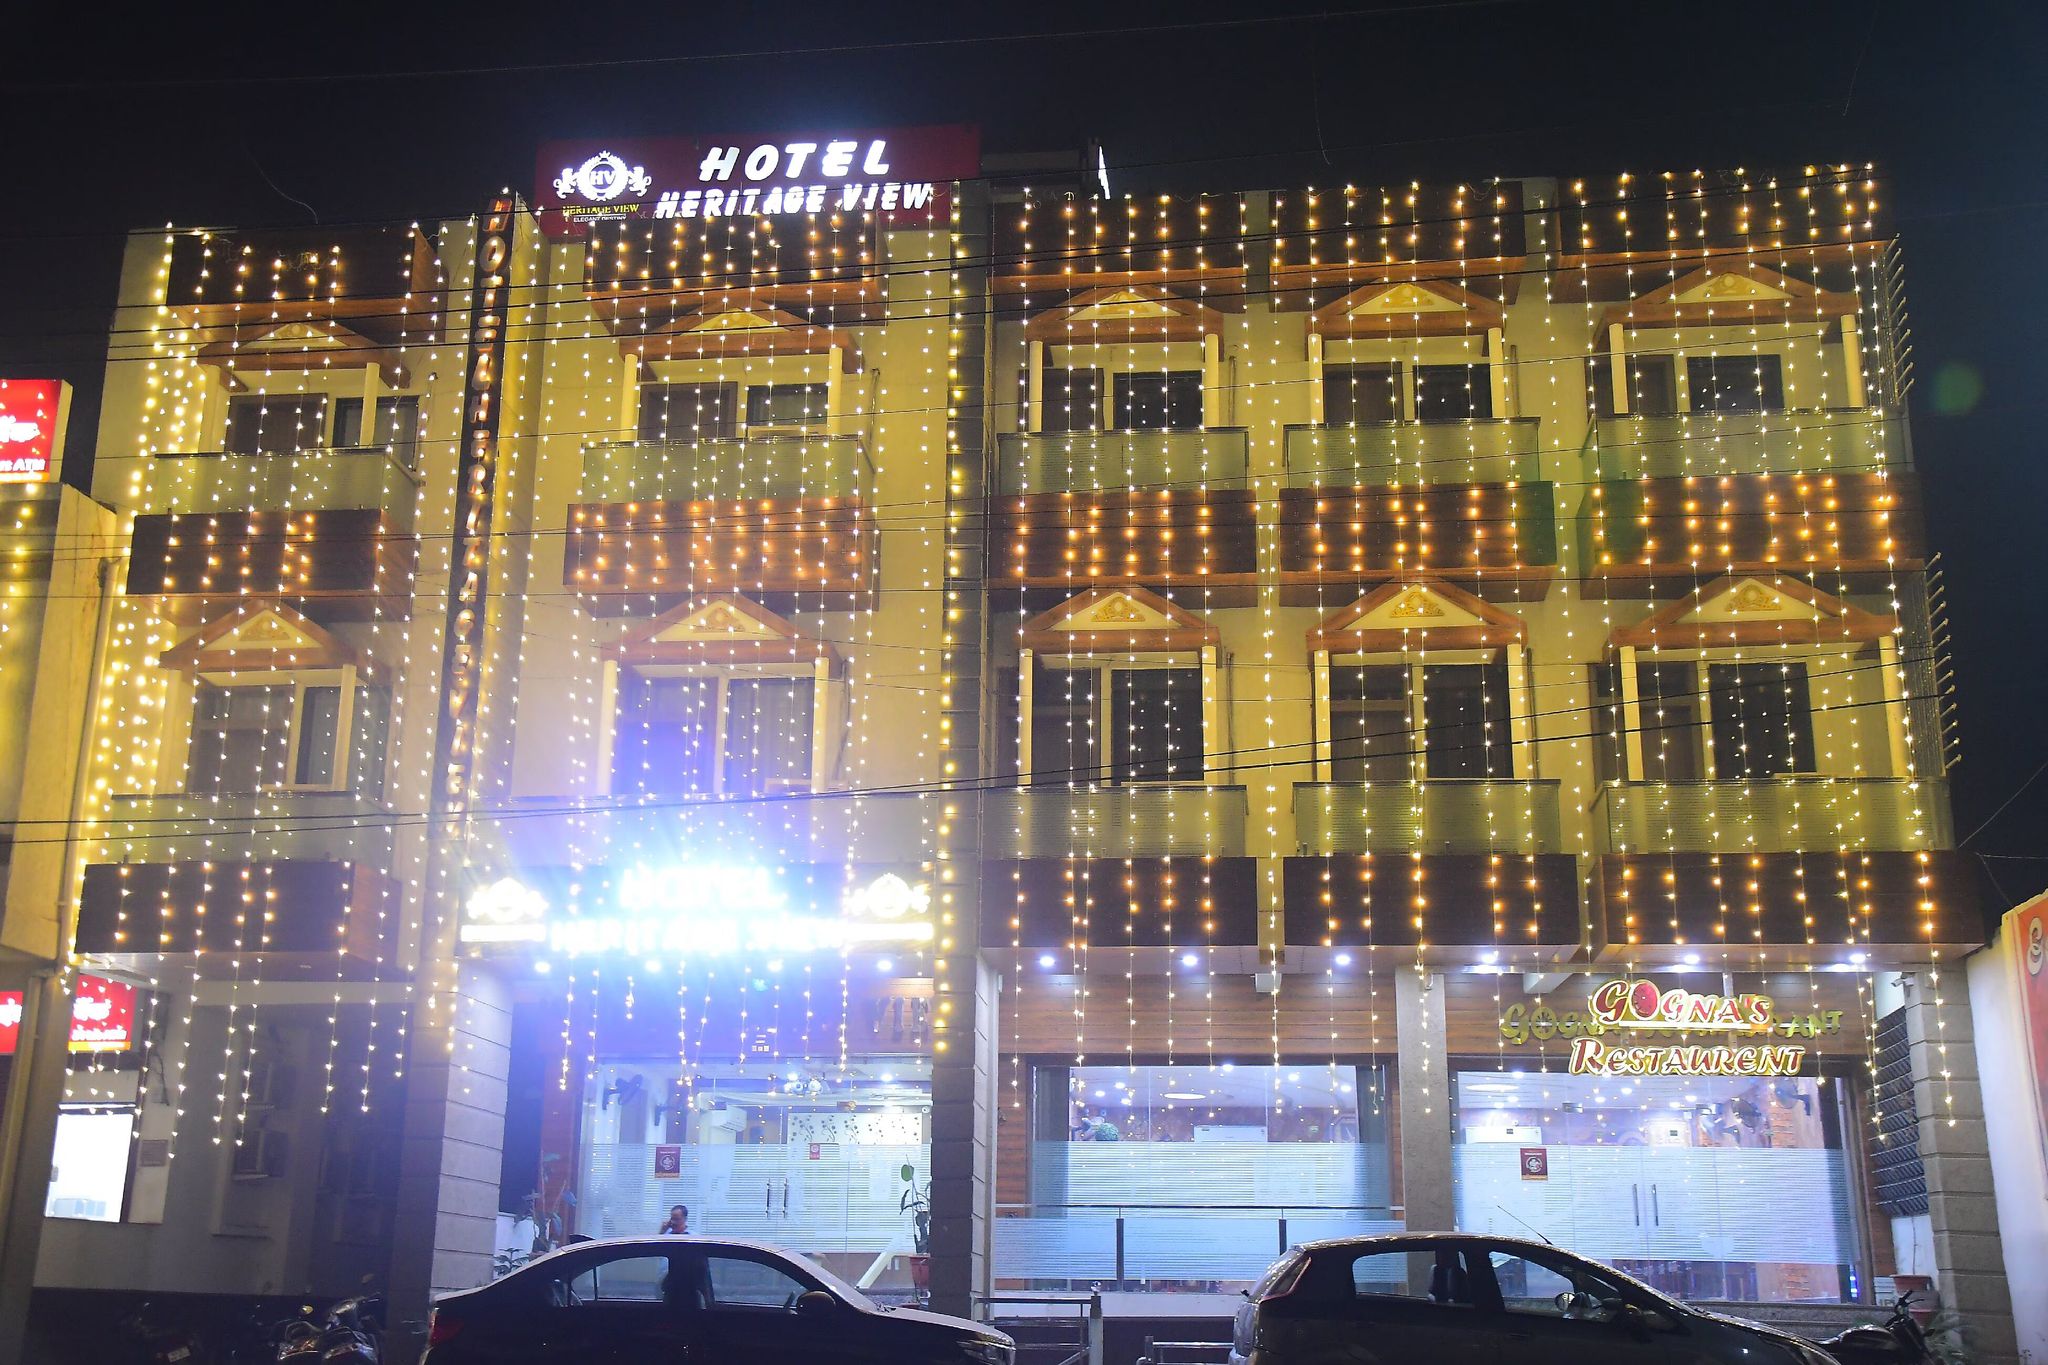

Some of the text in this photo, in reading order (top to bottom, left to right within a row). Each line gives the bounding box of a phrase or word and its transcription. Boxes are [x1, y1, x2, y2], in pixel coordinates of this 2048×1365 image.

[590, 170, 616, 186] HV
[699, 140, 890, 181] HOTEL
[562, 203, 639, 216] HERITAGE VIEW
[655, 182, 931, 219] HERITAGE VIEW
[1592, 978, 1771, 1025] GOGNA'S
[1569, 1037, 1804, 1076] RESTAURENT
